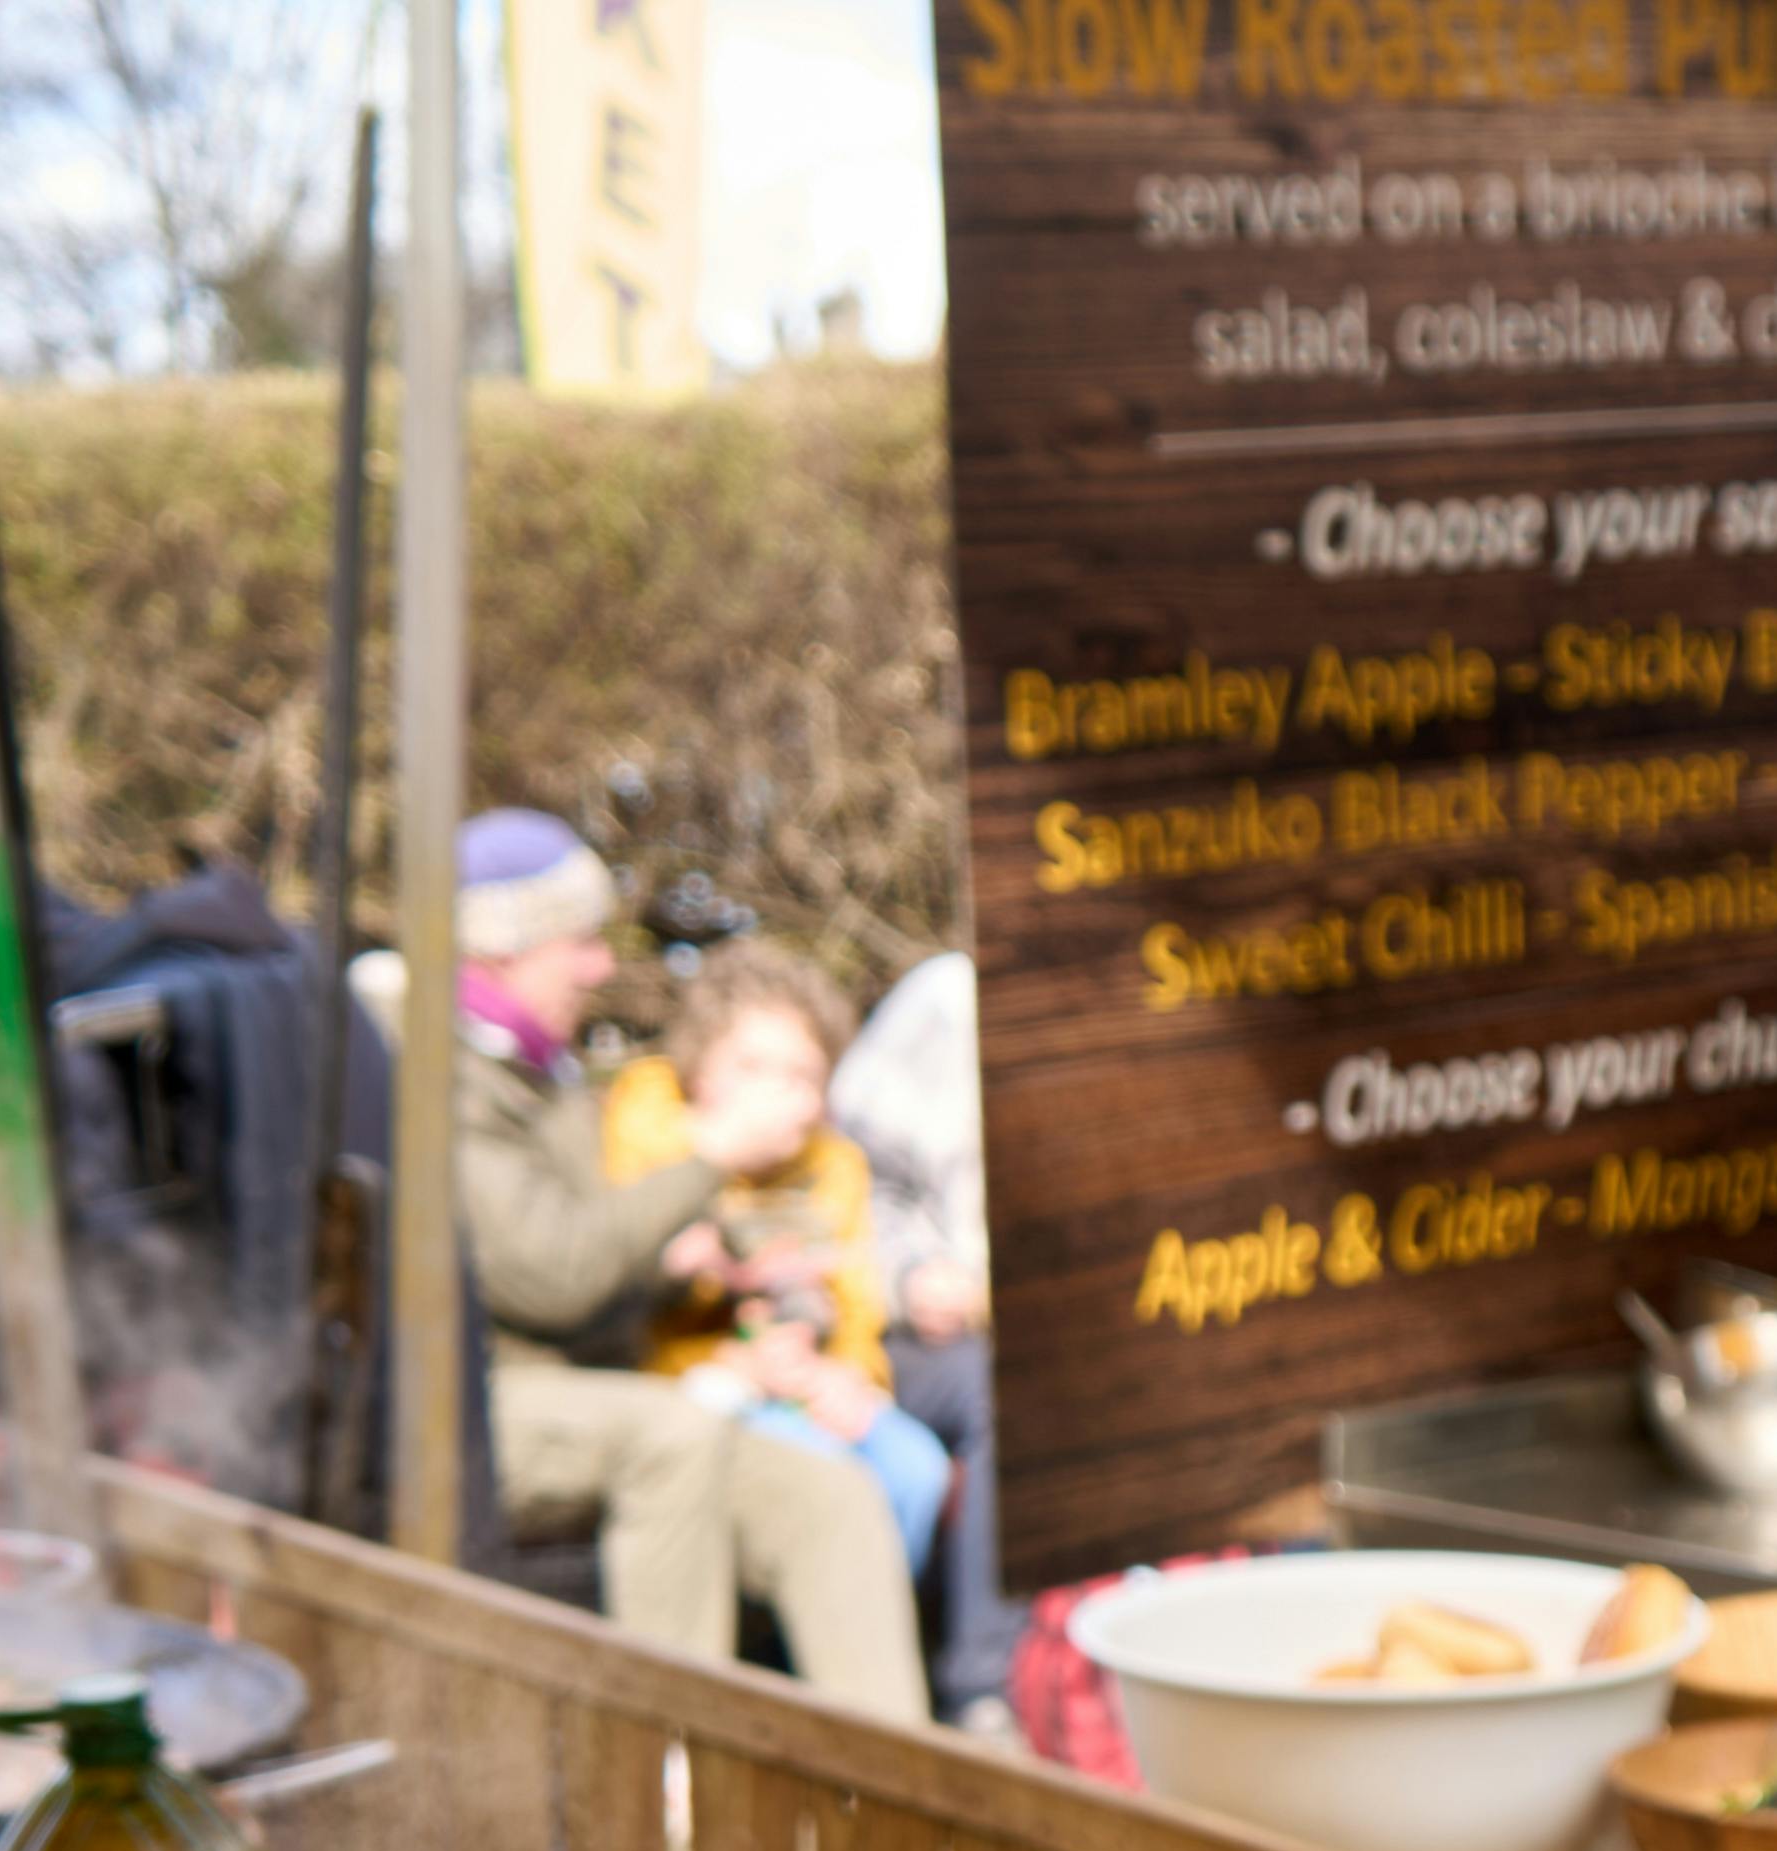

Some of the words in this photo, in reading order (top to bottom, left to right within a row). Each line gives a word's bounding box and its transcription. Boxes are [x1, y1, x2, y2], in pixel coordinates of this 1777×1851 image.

[963, 0, 1207, 97] Slow
[1234, 0, 1624, 98] Roasted
[1134, 152, 1363, 250] served
[1370, 171, 1464, 246] on
[1471, 171, 1518, 244] a
[1524, 151, 1764, 243] brioche
[1193, 284, 1388, 386] salad,
[1396, 279, 1673, 376] coleslaw
[1676, 274, 1738, 366] &
[1300, 480, 1549, 577] Choose
[1552, 486, 1712, 582] your
[1004, 645, 1292, 760] Bramley
[1298, 641, 1498, 746] Apple
[1543, 611, 1736, 713] Sticky
[1034, 775, 1322, 894] Sanzuko
[1330, 751, 1512, 854] Black
[1516, 748, 1746, 845] Pepper
[1140, 906, 1353, 1013] Sweet
[1360, 877, 1525, 981] Chilli
[1322, 1046, 1542, 1148] Choose
[1544, 1026, 1687, 1132] your
[1133, 1203, 1321, 1336] Apple
[1324, 1191, 1384, 1288] &
[1389, 1169, 1552, 1274] Cider
